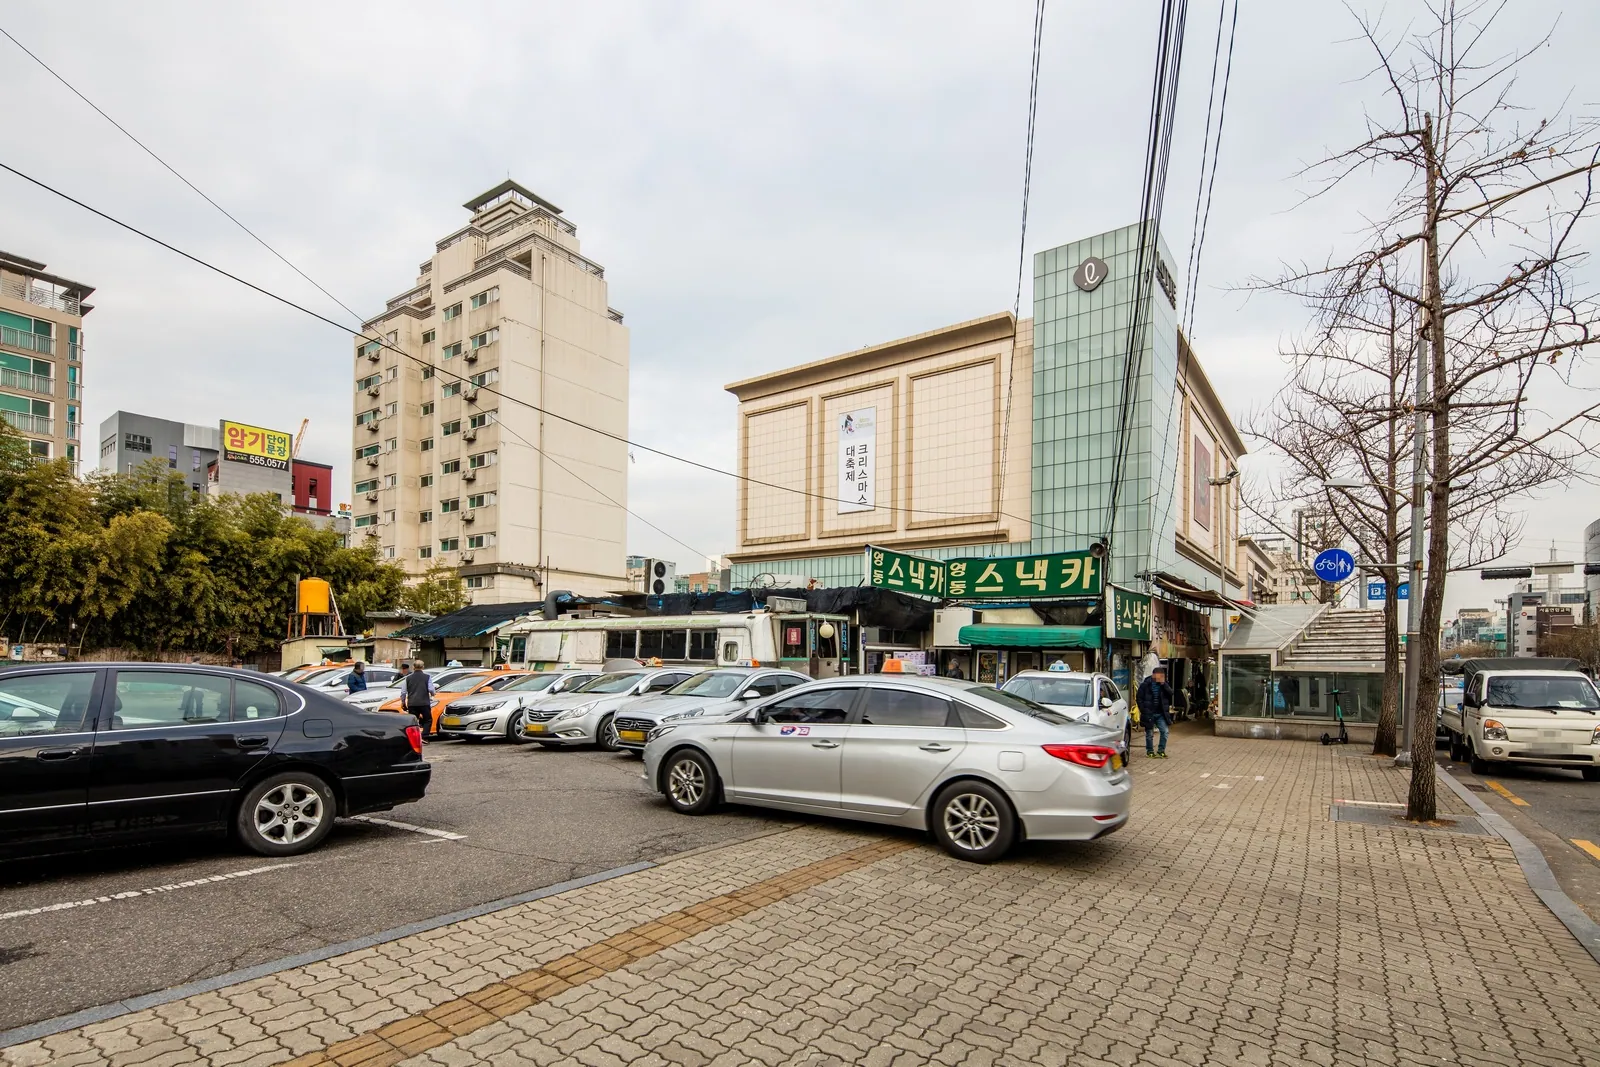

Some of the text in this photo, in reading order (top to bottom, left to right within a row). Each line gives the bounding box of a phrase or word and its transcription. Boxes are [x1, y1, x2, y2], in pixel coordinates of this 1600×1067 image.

[227, 427, 266, 454] 암기
[266, 434, 287, 448] 단어
[266, 444, 287, 457] 문장
[249, 455, 287, 470] 555.0577
[845, 445, 856, 482] 대축제
[857, 443, 869, 505] 크리스마스
[873, 551, 945, 594] 영동 스낵카
[949, 556, 1096, 595] 영동 스낵카
[1115, 594, 1122, 631] 영동
[1122, 599, 1151, 634] 스낵카
